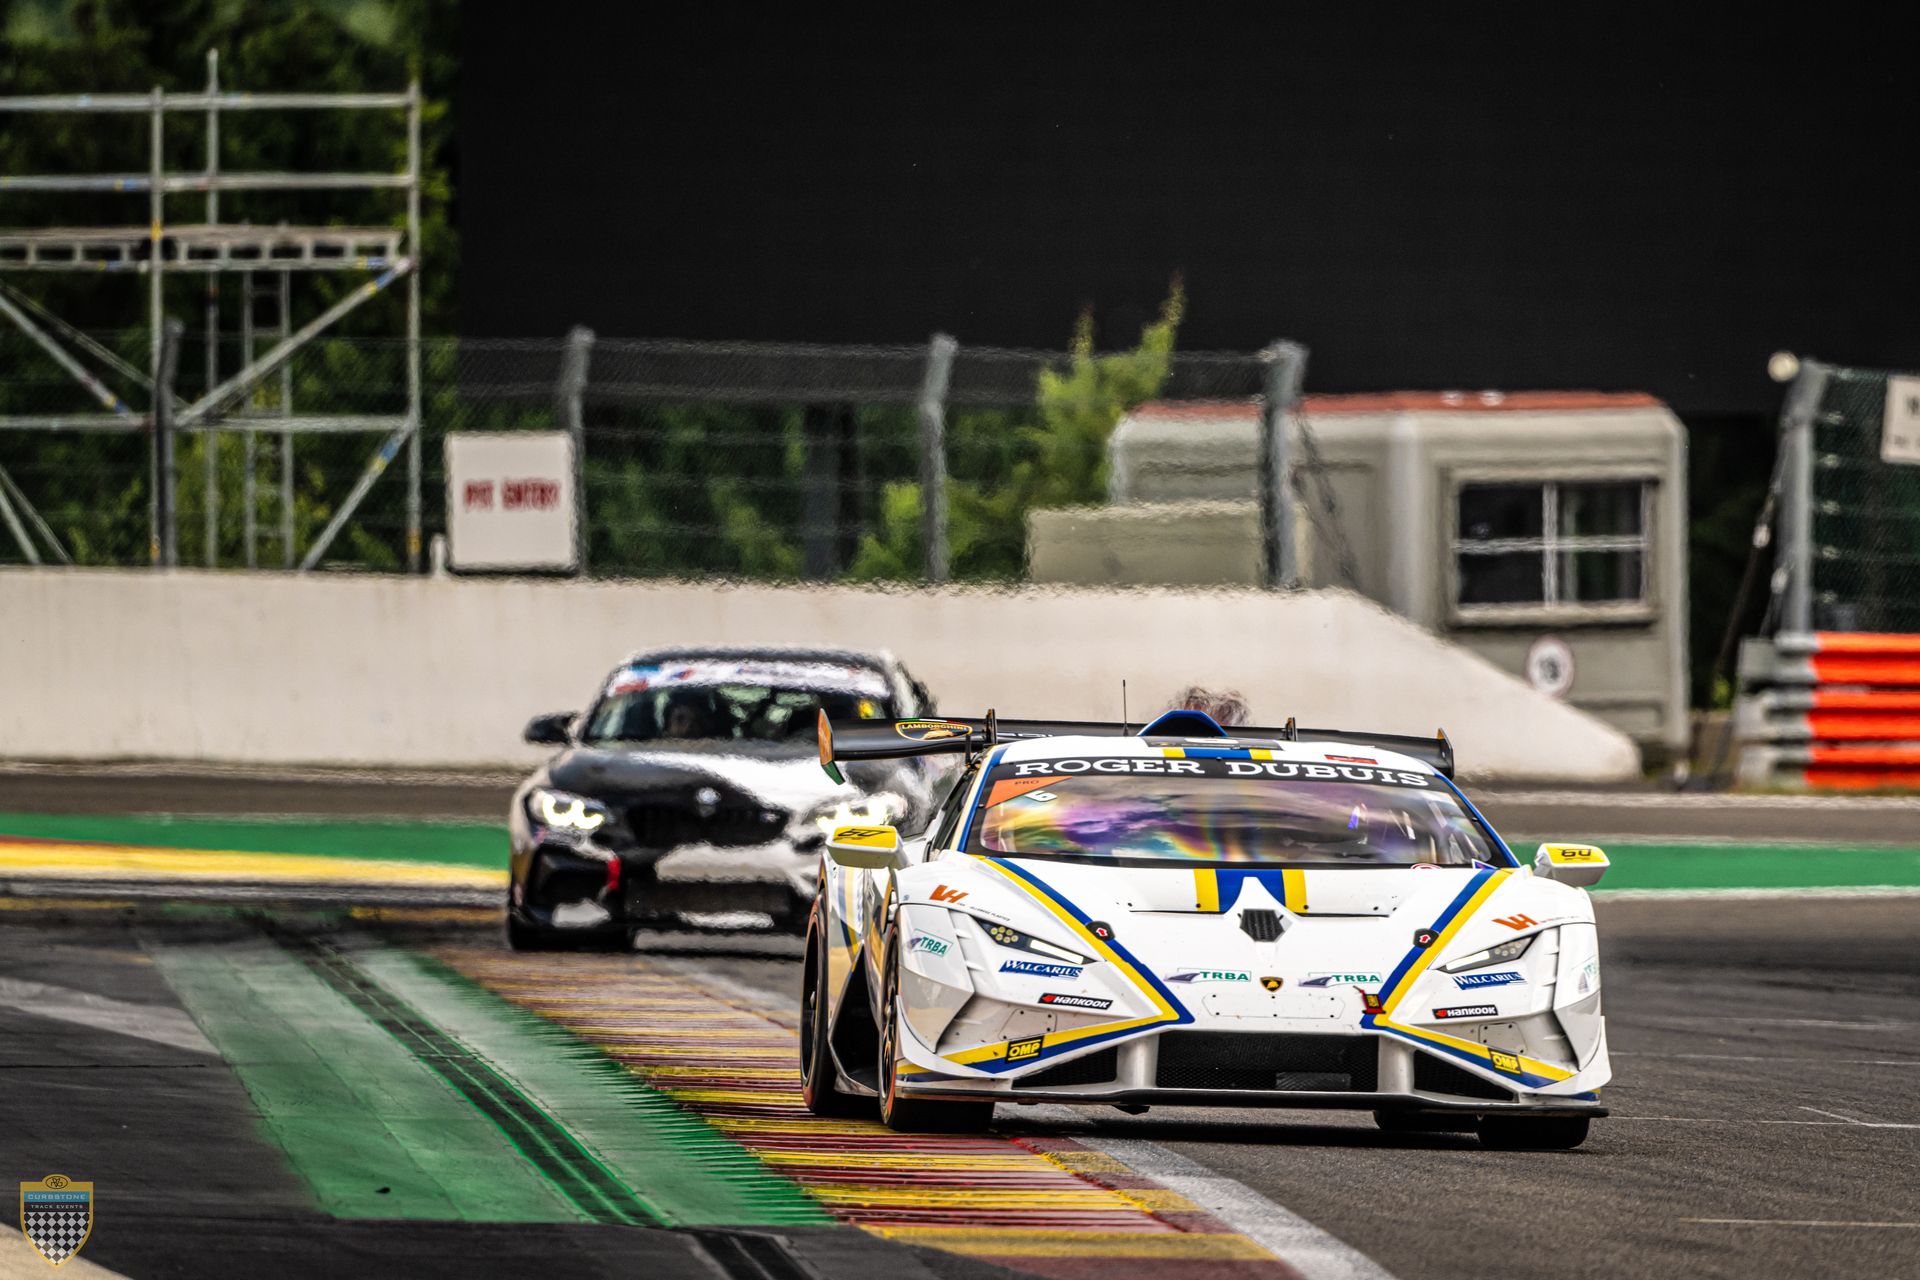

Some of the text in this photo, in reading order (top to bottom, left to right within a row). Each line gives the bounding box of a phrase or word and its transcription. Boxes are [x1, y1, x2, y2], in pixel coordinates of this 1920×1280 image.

[1014, 757, 1430, 787] ROGER DUBUIS
[920, 936, 948, 955] TRBA
[1003, 959, 1082, 978] WALCARIUS
[1199, 970, 1250, 982] TRBA
[1331, 974, 1381, 984] TRBA
[1008, 1042, 1041, 1058] OMP
[1493, 1054, 1519, 1070] OMP
